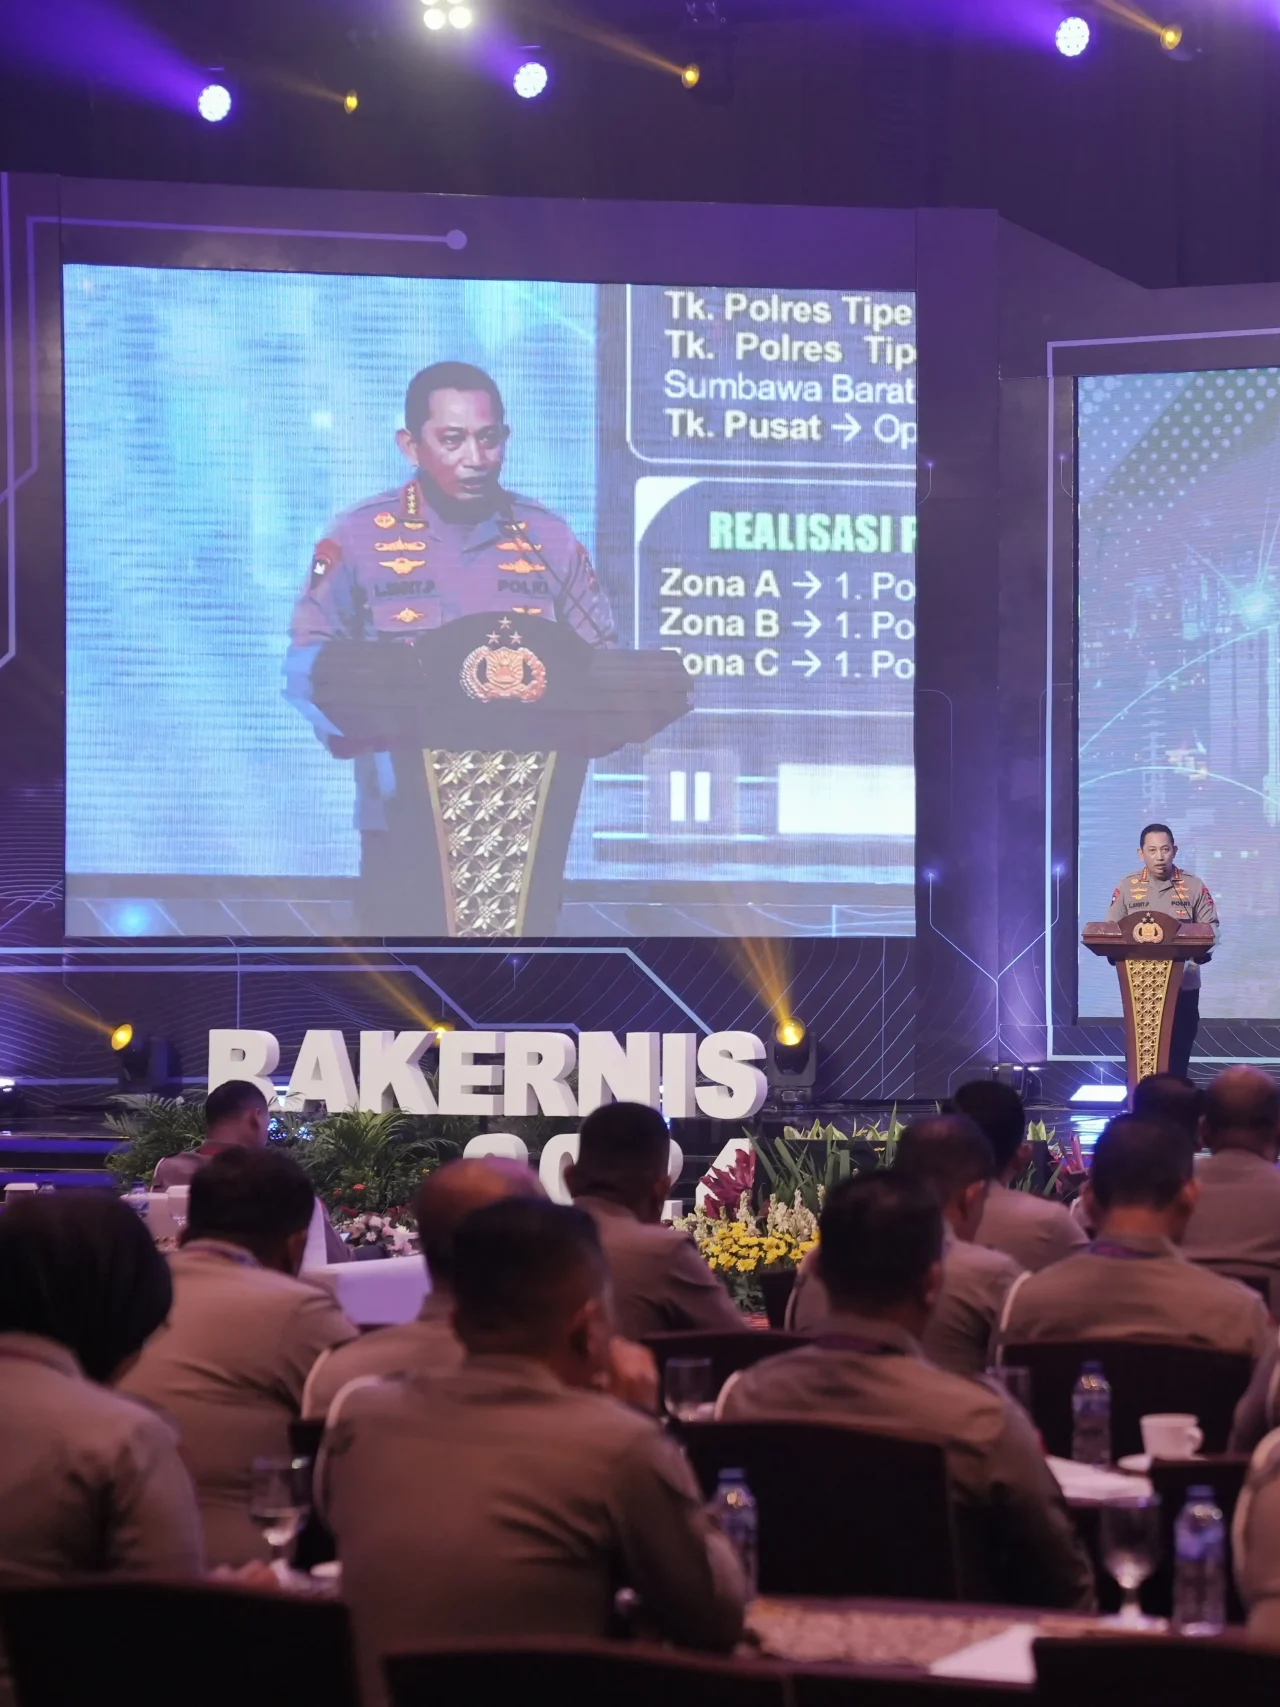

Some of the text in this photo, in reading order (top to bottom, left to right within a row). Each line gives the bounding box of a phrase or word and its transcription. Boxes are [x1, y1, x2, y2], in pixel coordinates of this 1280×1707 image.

[663, 289, 913, 331] Tk. Polres Tipe
[663, 368, 917, 408] Sumbawa Barat
[663, 407, 821, 441] Tk. Pusat
[709, 510, 894, 554] REALISASI
[659, 567, 780, 598] Zona A
[207, 1028, 768, 1120] RAKERNIS
